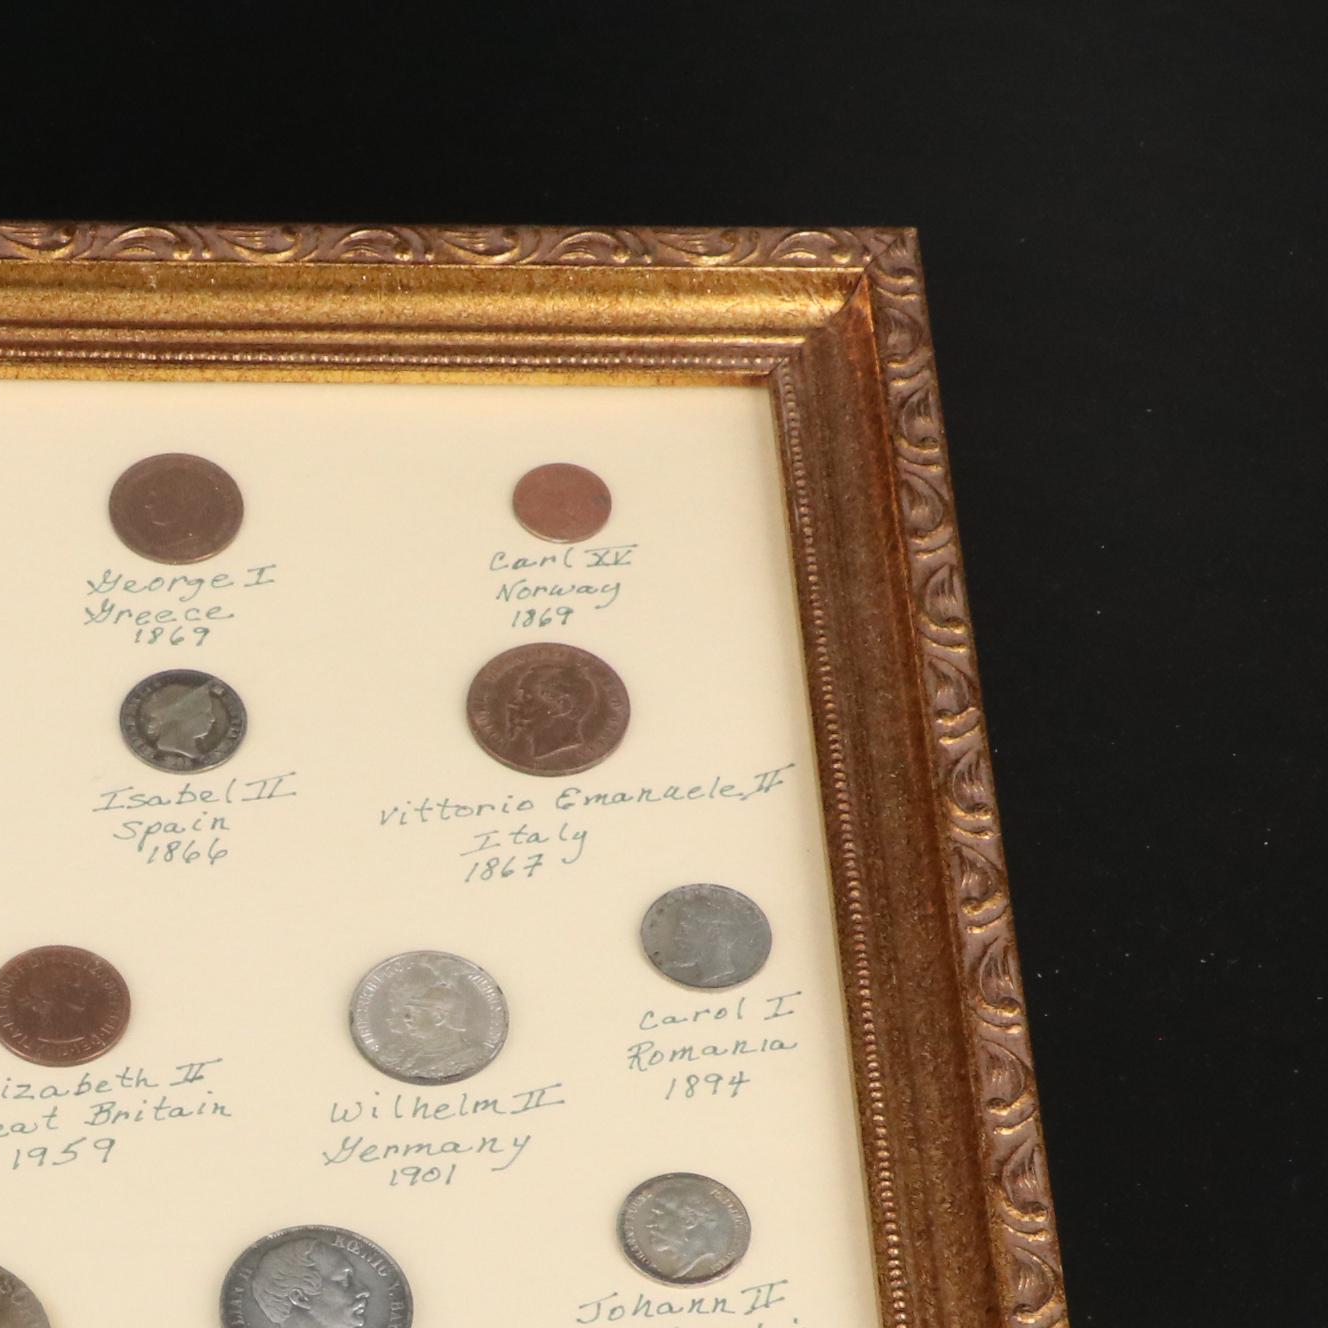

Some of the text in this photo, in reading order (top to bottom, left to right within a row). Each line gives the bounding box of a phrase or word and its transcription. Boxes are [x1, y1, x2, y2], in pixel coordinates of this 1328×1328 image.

[489, 544, 638, 571] Carl XV
[85, 563, 278, 603] George I
[496, 578, 621, 610] Norway
[84, 598, 235, 626] Greece
[512, 606, 574, 628] 1869
[134, 626, 210, 647] 1869
[91, 770, 298, 813] Isabel II
[555, 776, 745, 811] Emanuele
[743, 763, 795, 802] II
[146, 838, 230, 866] 1866
[460, 822, 589, 865] Italy
[464, 853, 544, 883] 1867
[638, 991, 802, 1032] Carol I
[168, 1057, 225, 1086] II
[627, 1038, 798, 1072] Romania
[665, 1071, 751, 1100] 1894
[85, 1089, 234, 1127] Britain
[329, 1082, 567, 1124] Wilhelm II
[12, 1137, 116, 1170] 1959
[322, 1135, 531, 1172] Germany
[389, 1164, 456, 1187] 1901
[575, 1279, 790, 1326] Johann II
